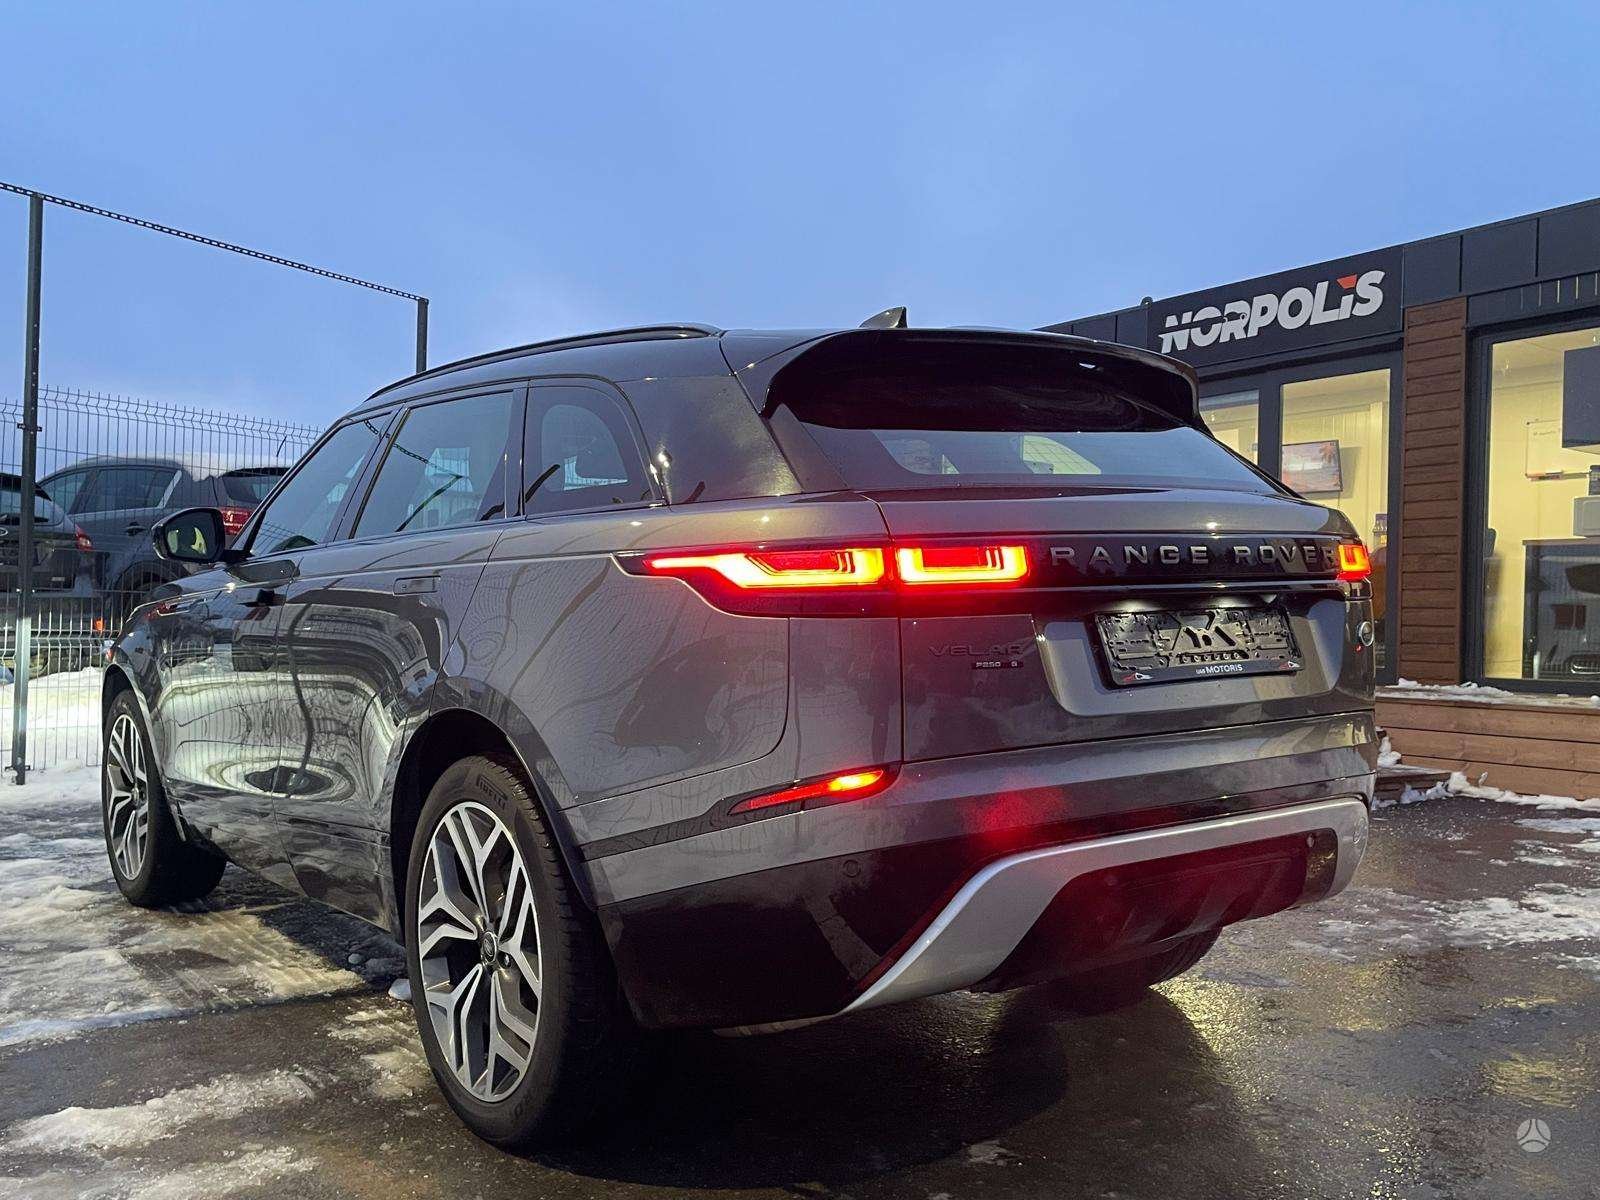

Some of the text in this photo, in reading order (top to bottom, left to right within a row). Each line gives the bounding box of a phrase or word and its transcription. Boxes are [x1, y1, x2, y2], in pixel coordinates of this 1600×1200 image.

[1050, 545, 1338, 566] RANGE ROVER
[929, 644, 1024, 657] VELAR
[1205, 663, 1243, 674] MOTORIS
